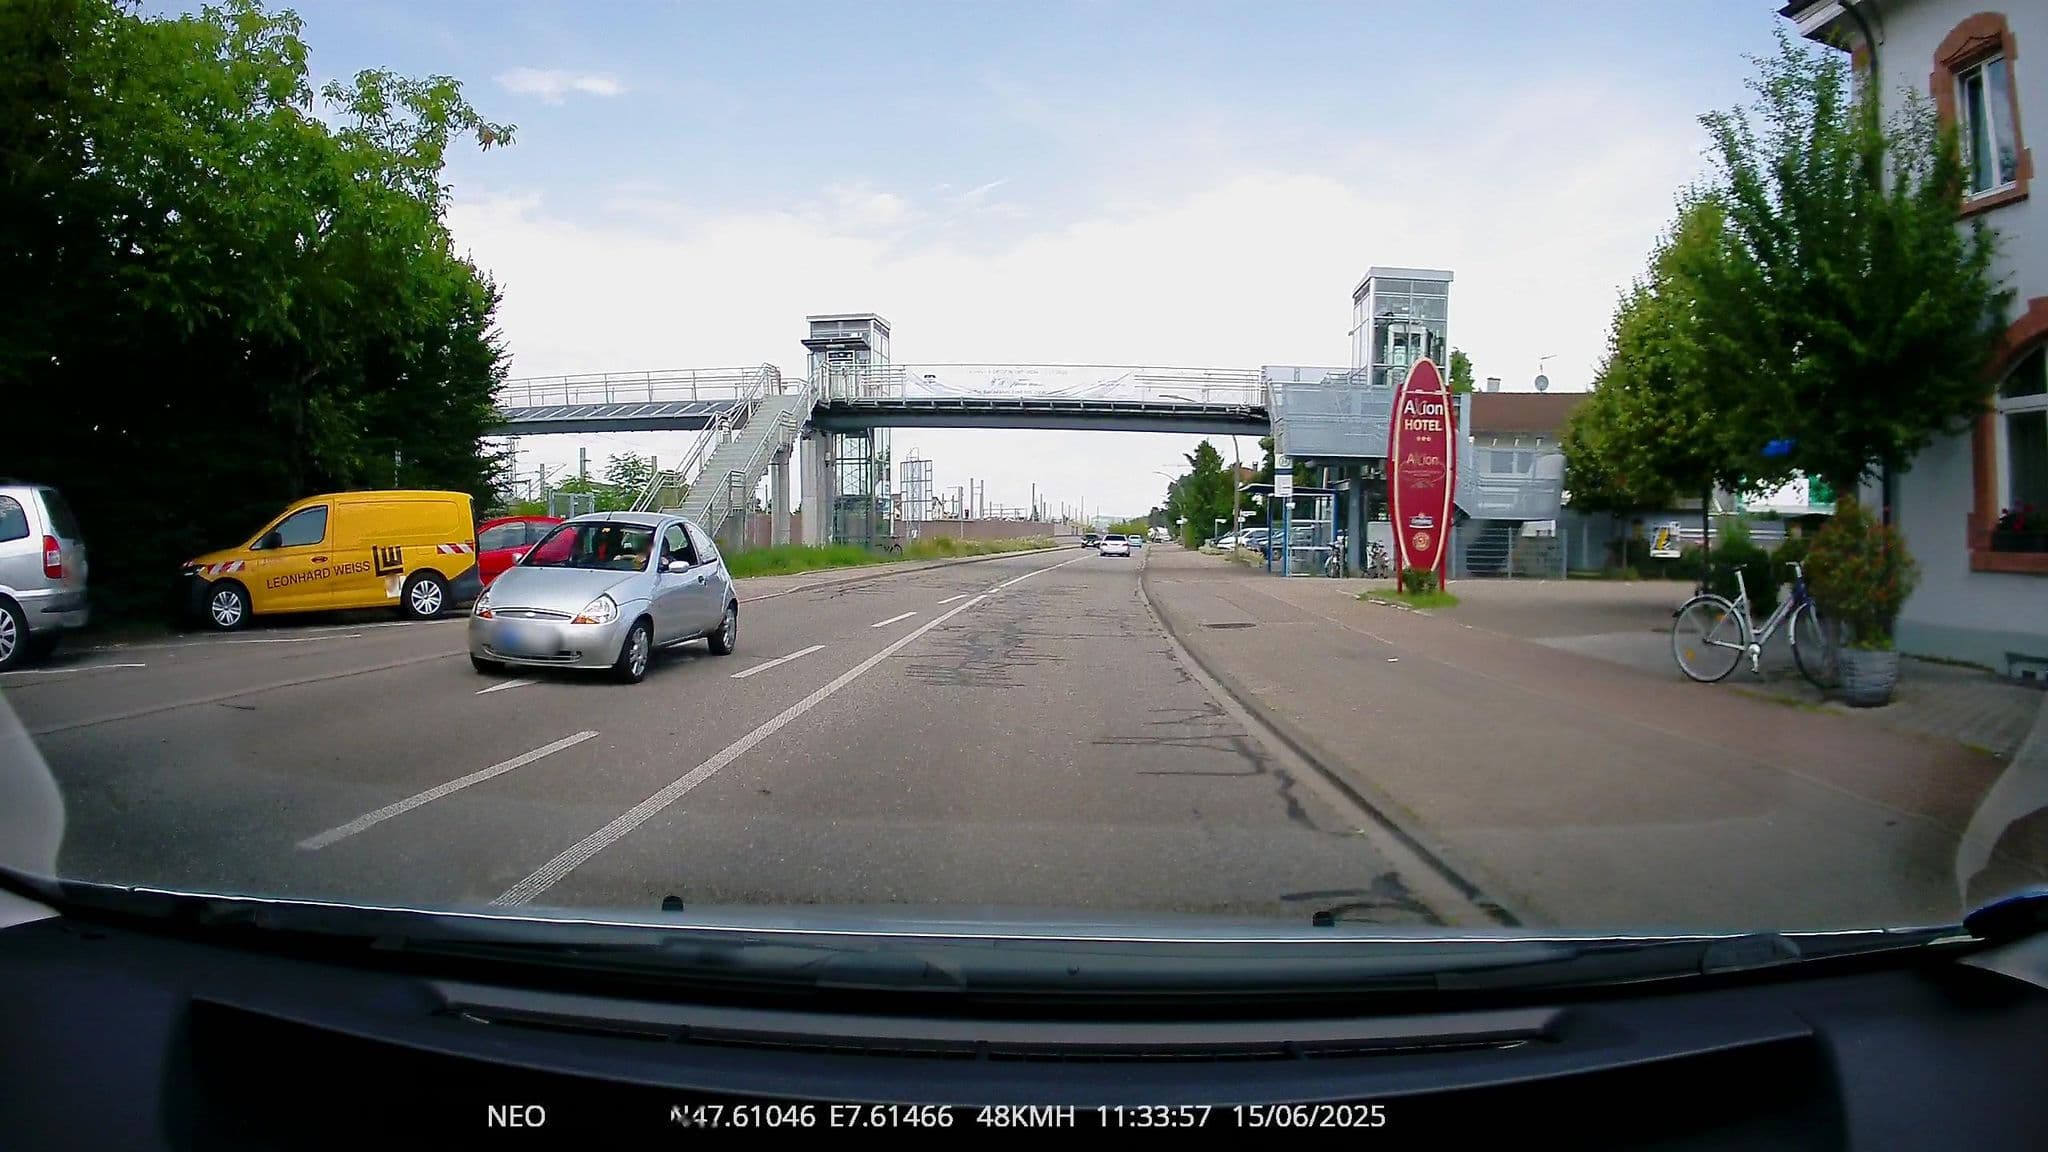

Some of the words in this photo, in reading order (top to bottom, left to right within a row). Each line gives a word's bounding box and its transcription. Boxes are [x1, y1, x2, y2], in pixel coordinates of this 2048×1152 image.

[1404, 419, 1443, 432] HOTEL
[266, 567, 331, 589] LEONHARD
[333, 560, 371, 577] WEISS
